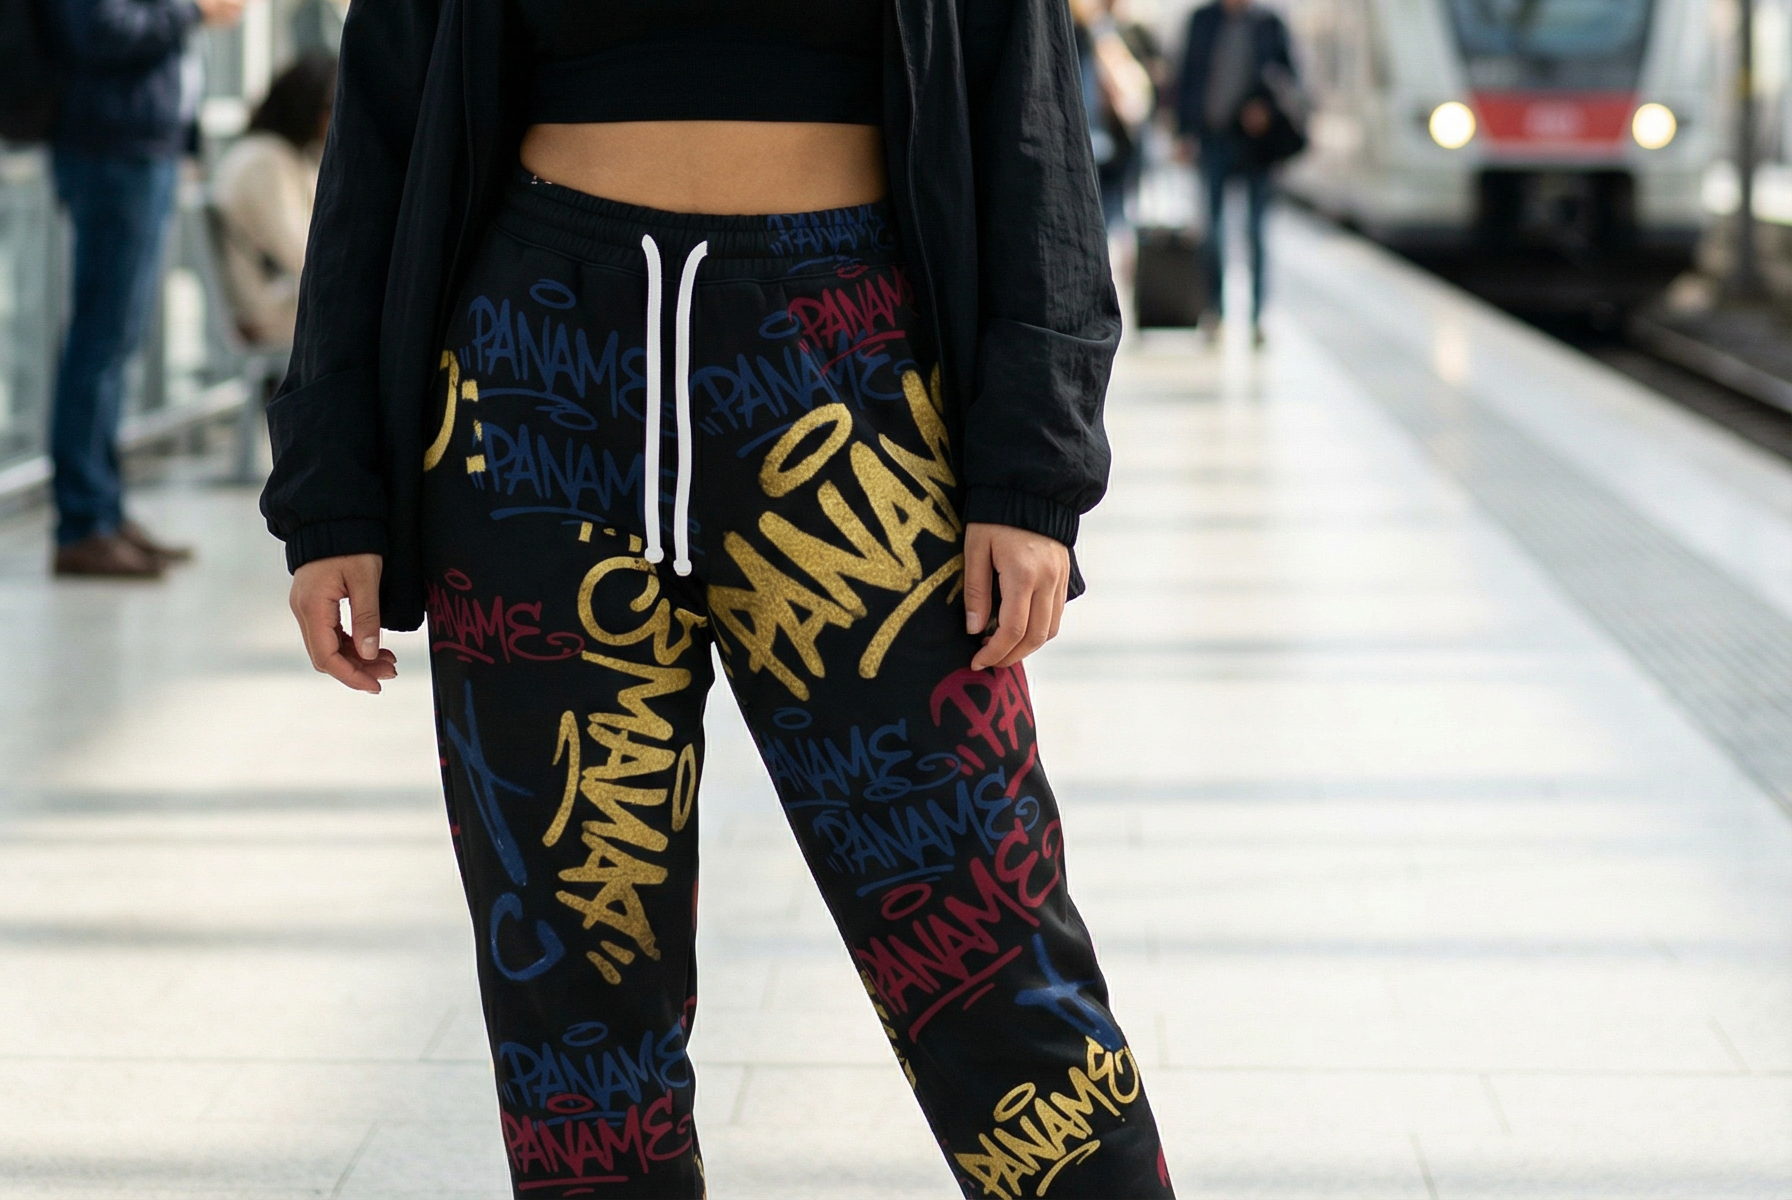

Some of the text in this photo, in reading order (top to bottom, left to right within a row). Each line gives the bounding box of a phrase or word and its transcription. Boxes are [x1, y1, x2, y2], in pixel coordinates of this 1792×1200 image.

[787, 264, 921, 350] PANAM
[706, 368, 962, 702] PANAM
[425, 579, 586, 663] ANAME
[762, 718, 961, 801] ANAME
[812, 765, 1040, 875] PANAME
[500, 1014, 690, 1110] PANAME
[501, 1087, 693, 1177] PANAME
